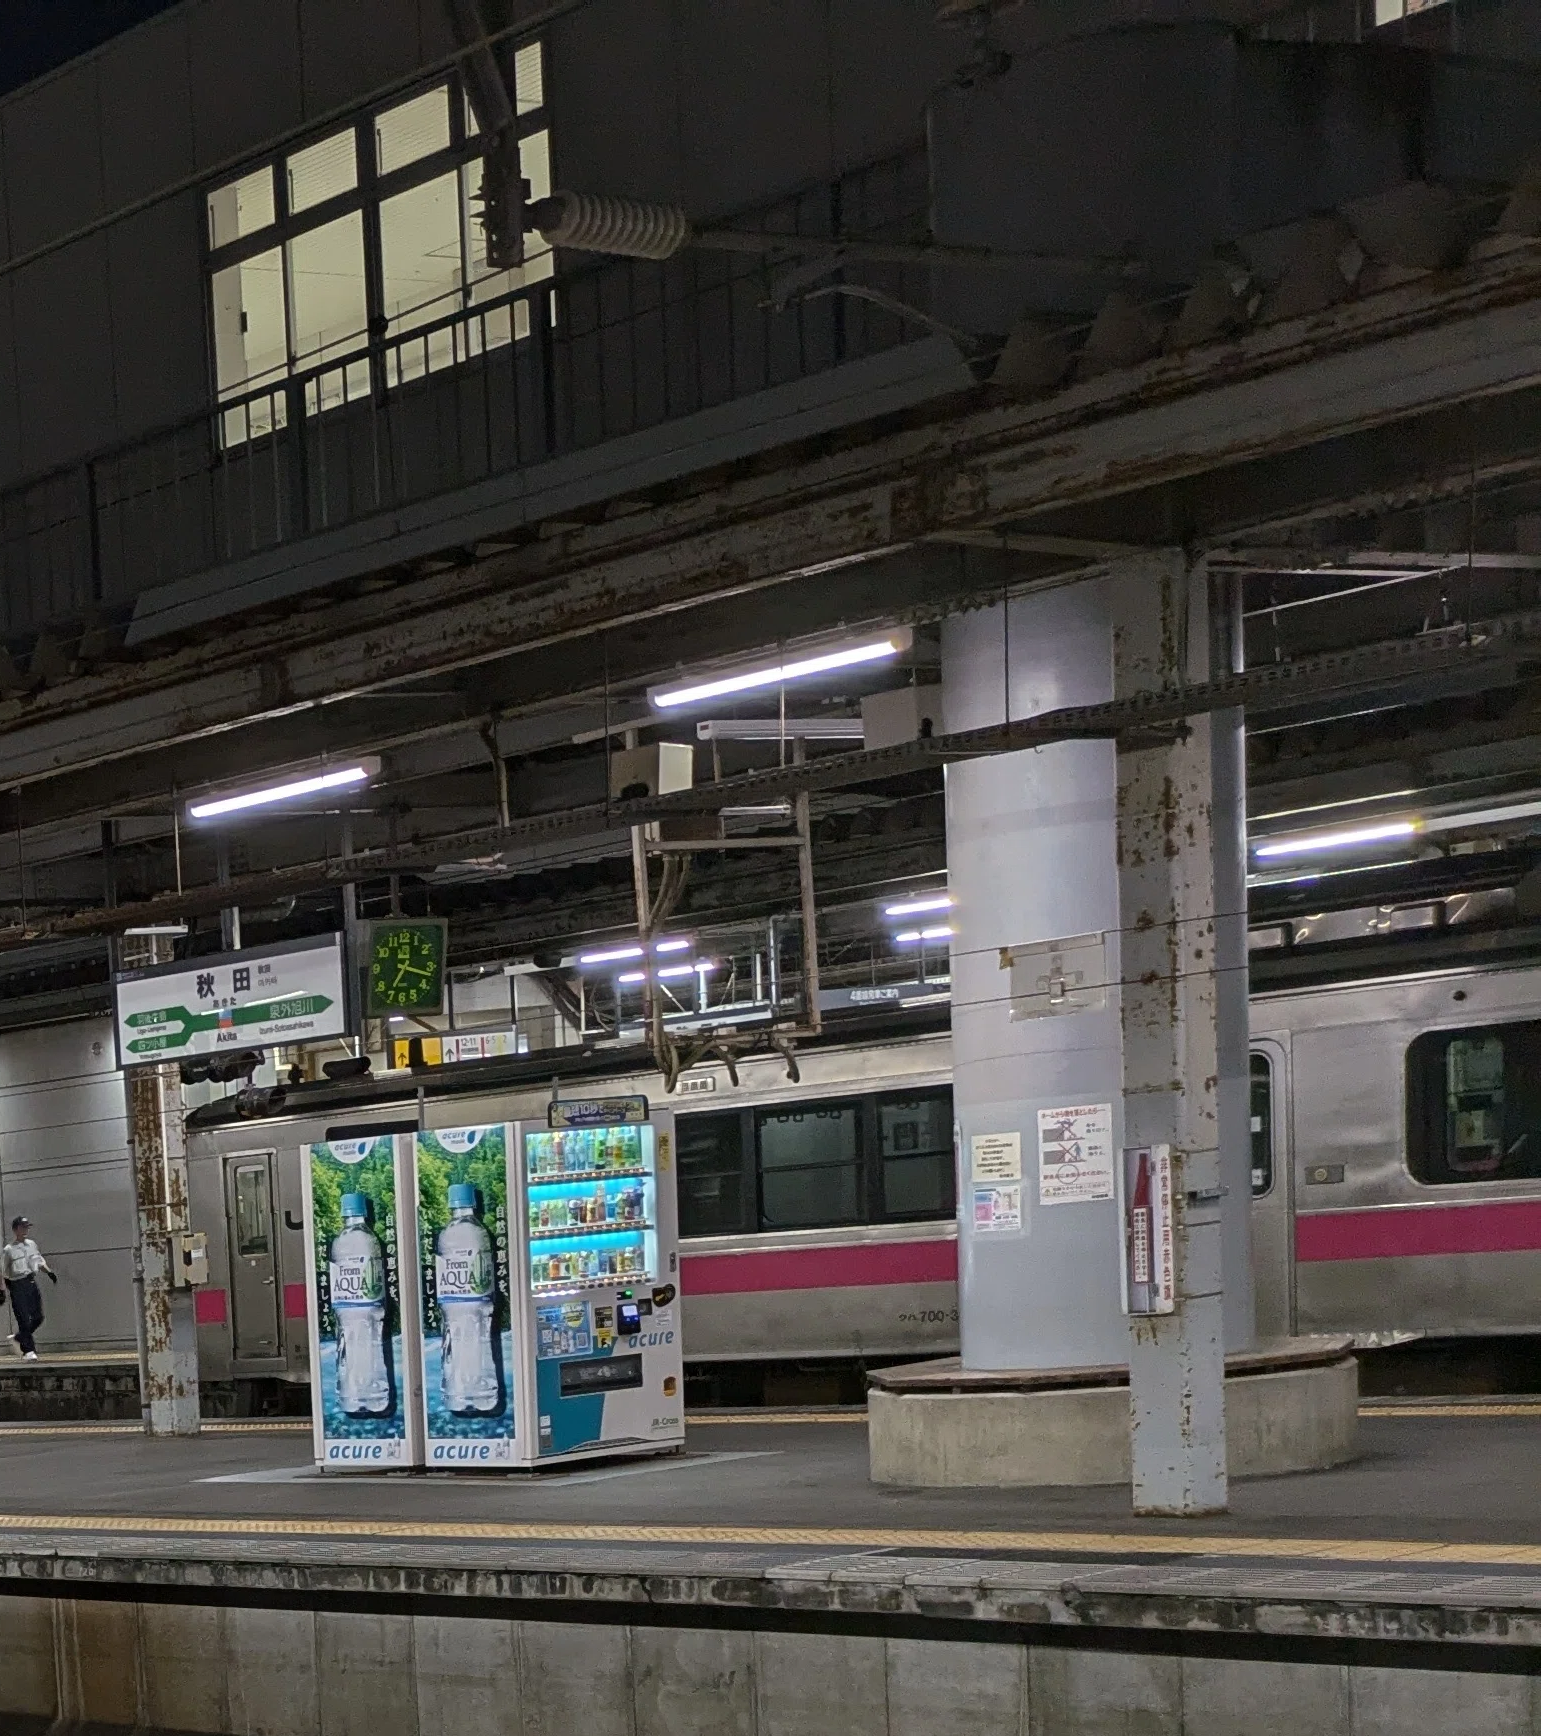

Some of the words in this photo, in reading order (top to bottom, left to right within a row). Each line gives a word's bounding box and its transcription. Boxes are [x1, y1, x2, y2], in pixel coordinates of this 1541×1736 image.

[388, 936, 398, 947] 11
[399, 932, 411, 943] 12
[421, 943, 429, 955] 2
[372, 963, 381, 975] 9
[426, 961, 434, 972] 3
[196, 967, 251, 999] 秋田
[377, 980, 385, 992] 8
[419, 979, 427, 989] 4
[387, 990, 395, 1001] 7
[398, 992, 406, 1003] 6
[409, 988, 417, 1000] 5
[216, 1032, 238, 1043] Akita
[445, 1258, 469, 1270] From
[339, 1265, 361, 1277] From
[333, 1276, 369, 1295] AQUA
[439, 1270, 477, 1289] AQUA
[628, 1330, 675, 1349] acure
[329, 1444, 383, 1460] acure
[433, 1444, 491, 1460] acure
